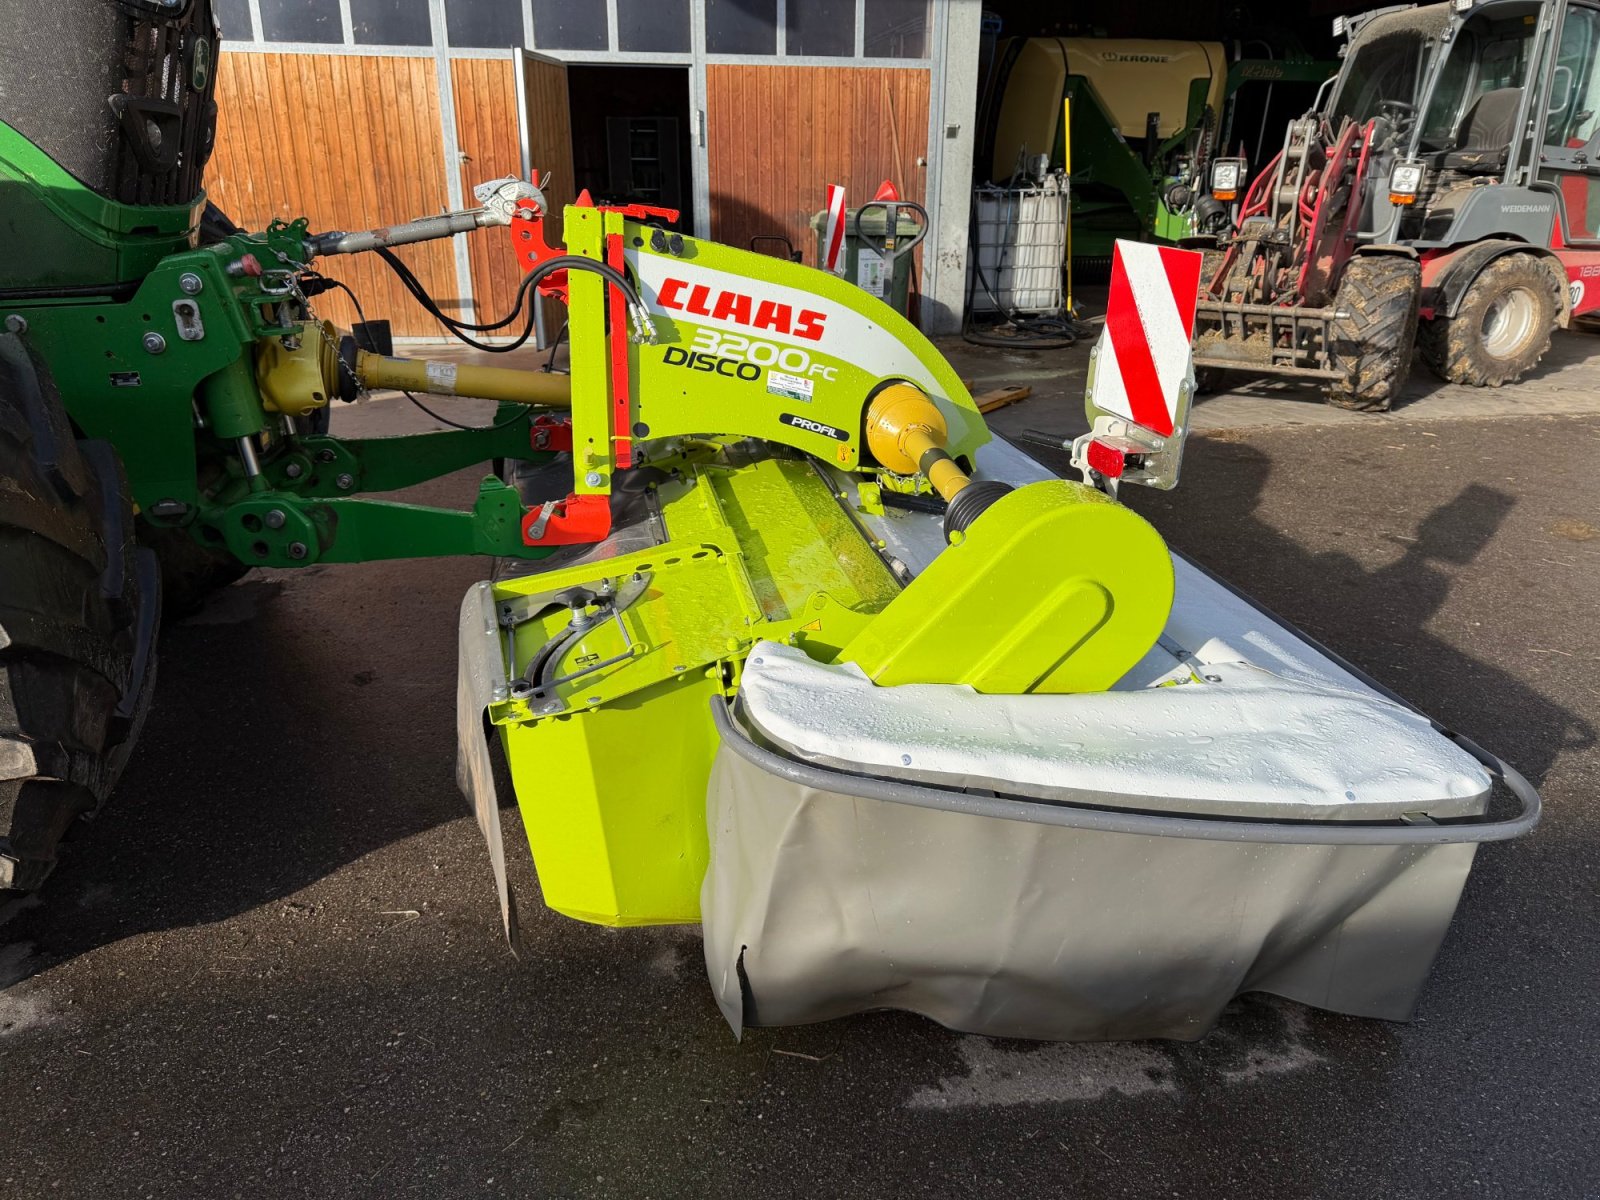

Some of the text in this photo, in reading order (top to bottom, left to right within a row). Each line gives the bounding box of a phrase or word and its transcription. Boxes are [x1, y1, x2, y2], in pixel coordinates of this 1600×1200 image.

[1119, 55, 1168, 63] KRONE
[1501, 204, 1550, 213] WEIDEMANN
[656, 277, 827, 342] CLAAS
[662, 346, 762, 381] DISCO
[791, 416, 838, 438] PROFIL
